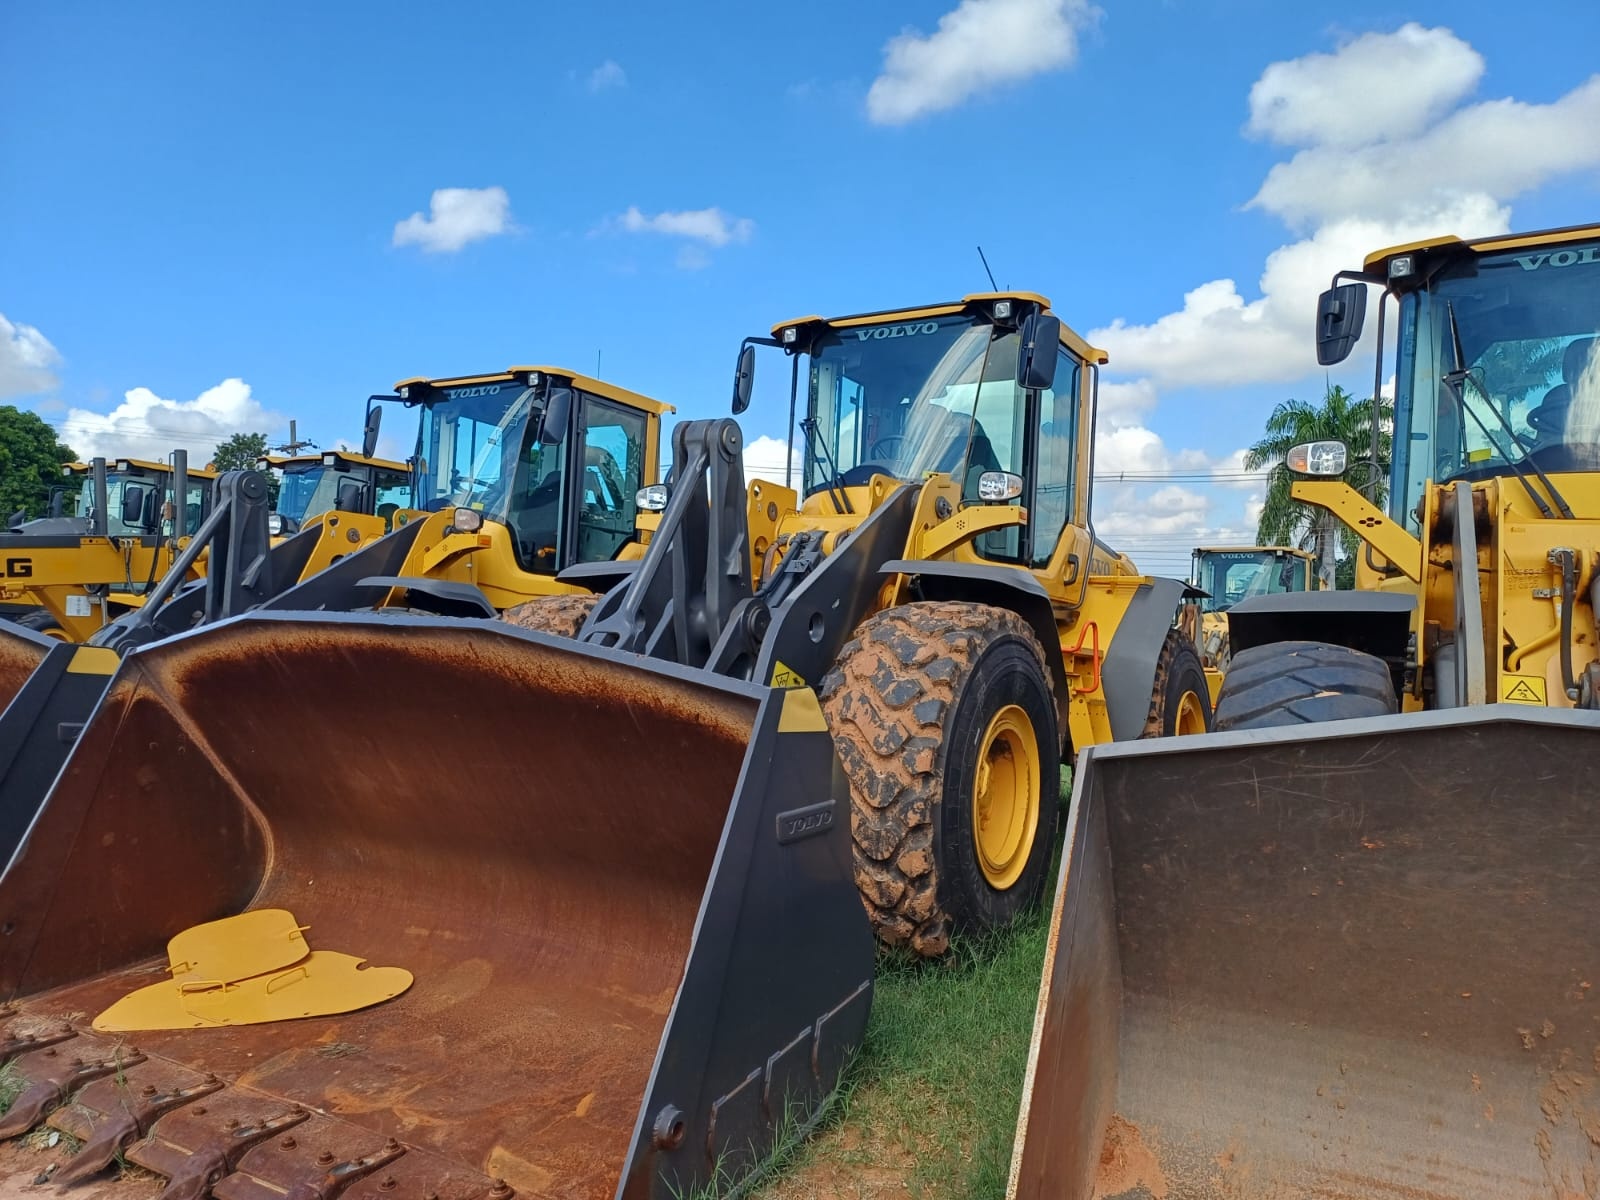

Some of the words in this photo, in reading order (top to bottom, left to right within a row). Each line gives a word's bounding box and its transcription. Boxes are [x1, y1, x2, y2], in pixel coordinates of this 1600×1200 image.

[855, 322, 939, 341] VOLVO
[449, 385, 500, 399] VOLVO
[788, 811, 832, 835] VOLVO
